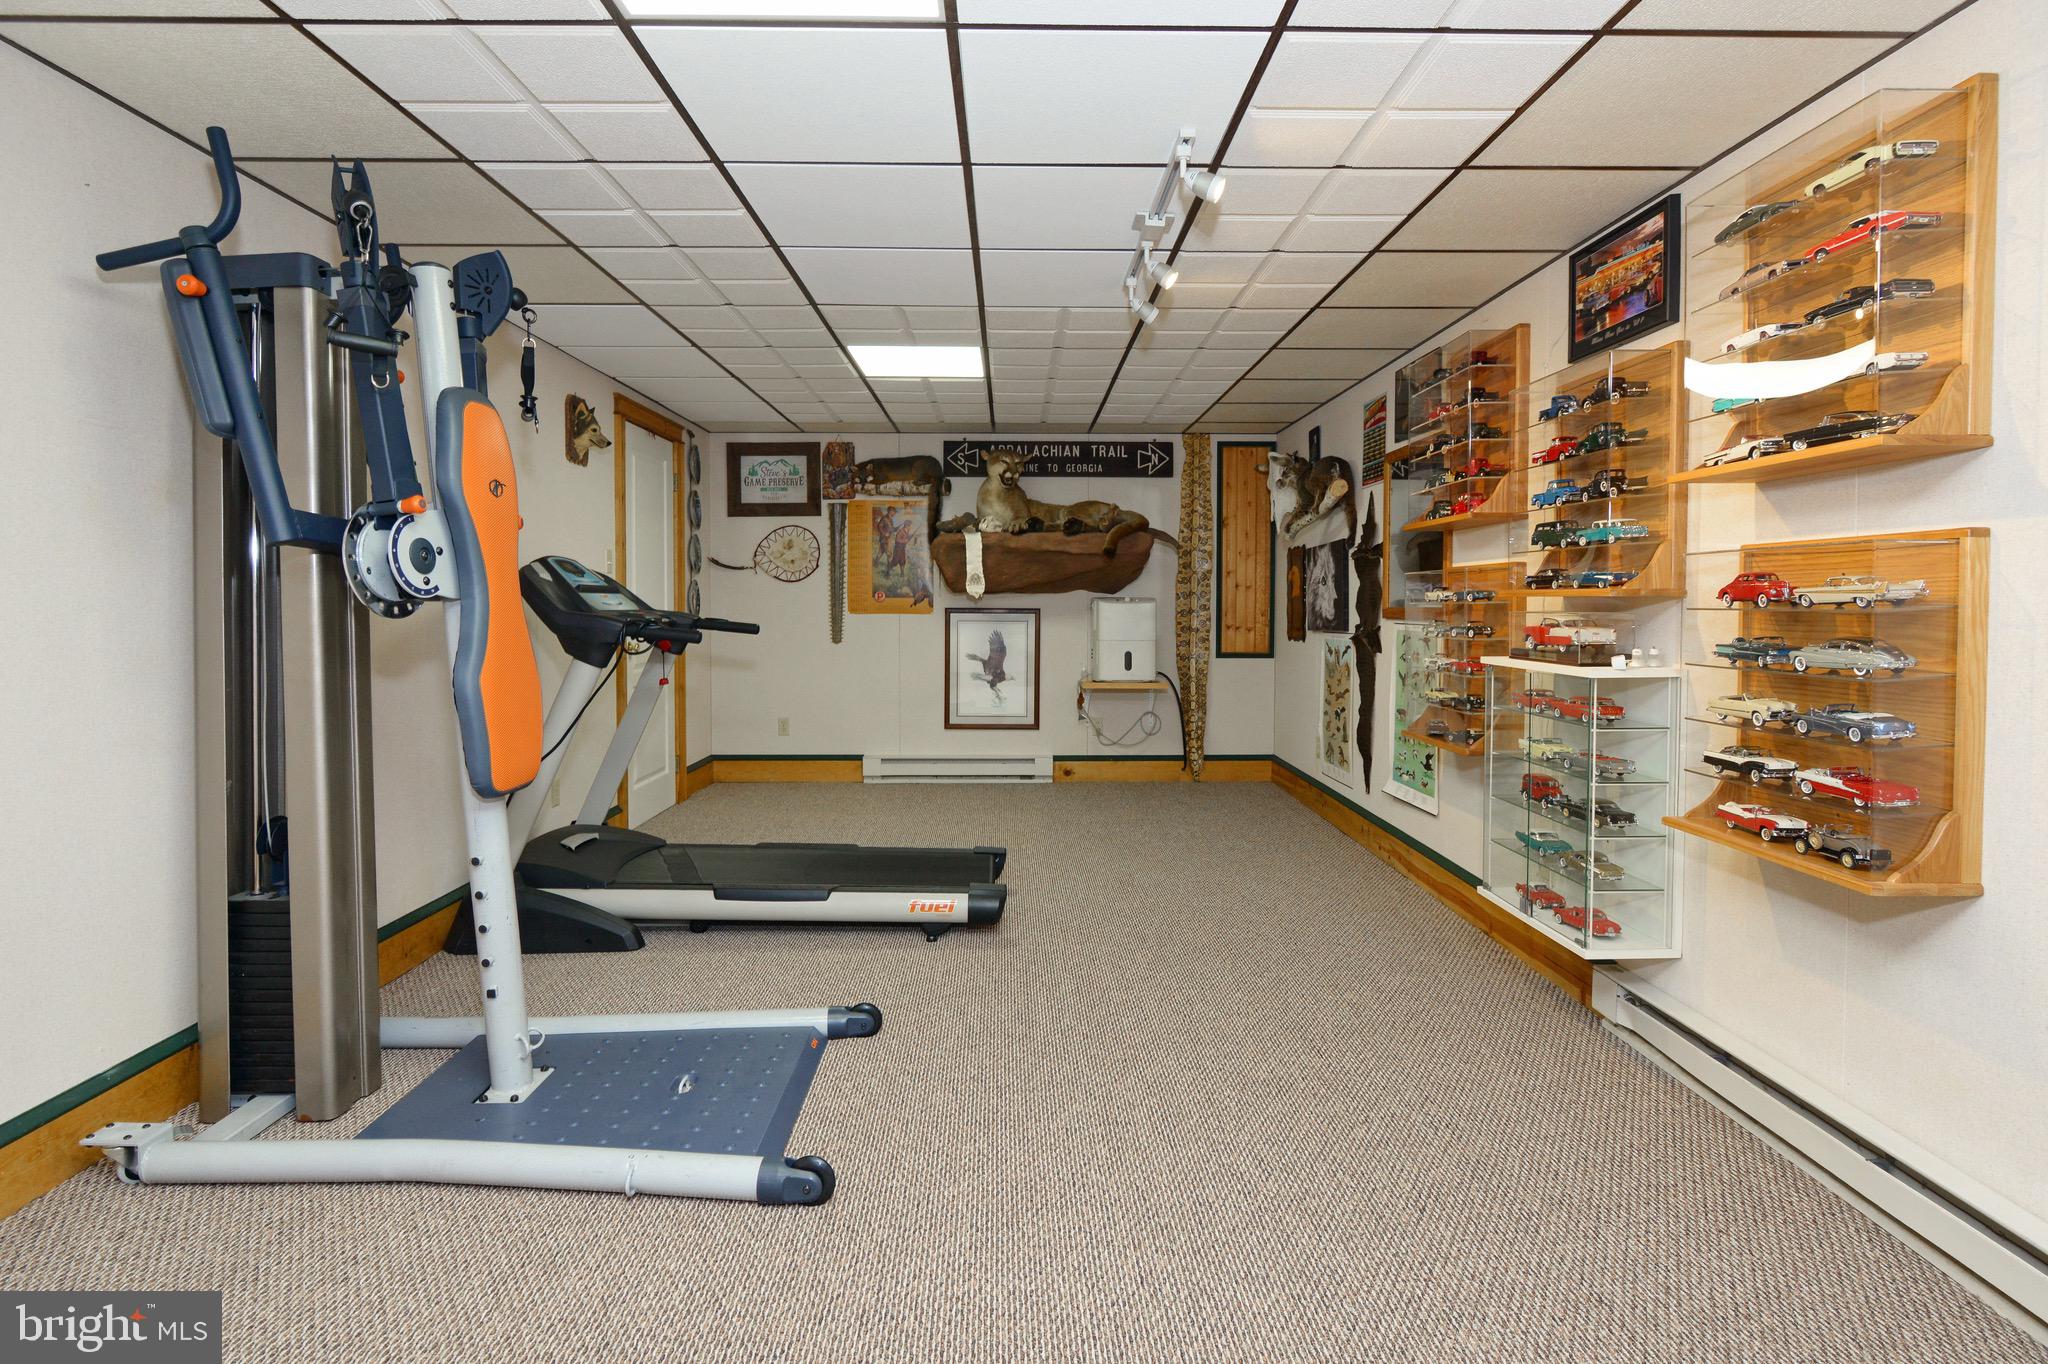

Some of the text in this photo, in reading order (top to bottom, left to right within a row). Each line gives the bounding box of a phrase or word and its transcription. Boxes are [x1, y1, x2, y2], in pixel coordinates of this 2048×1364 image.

[1091, 444, 1128, 458] TRAIL
[957, 452, 965, 465] S
[1151, 453, 1159, 465] N
[1047, 463, 1059, 473] TO
[1065, 463, 1103, 473] GEORGIA
[744, 475, 805, 487] GAME PRESERVE
[908, 899, 958, 913] fuel
